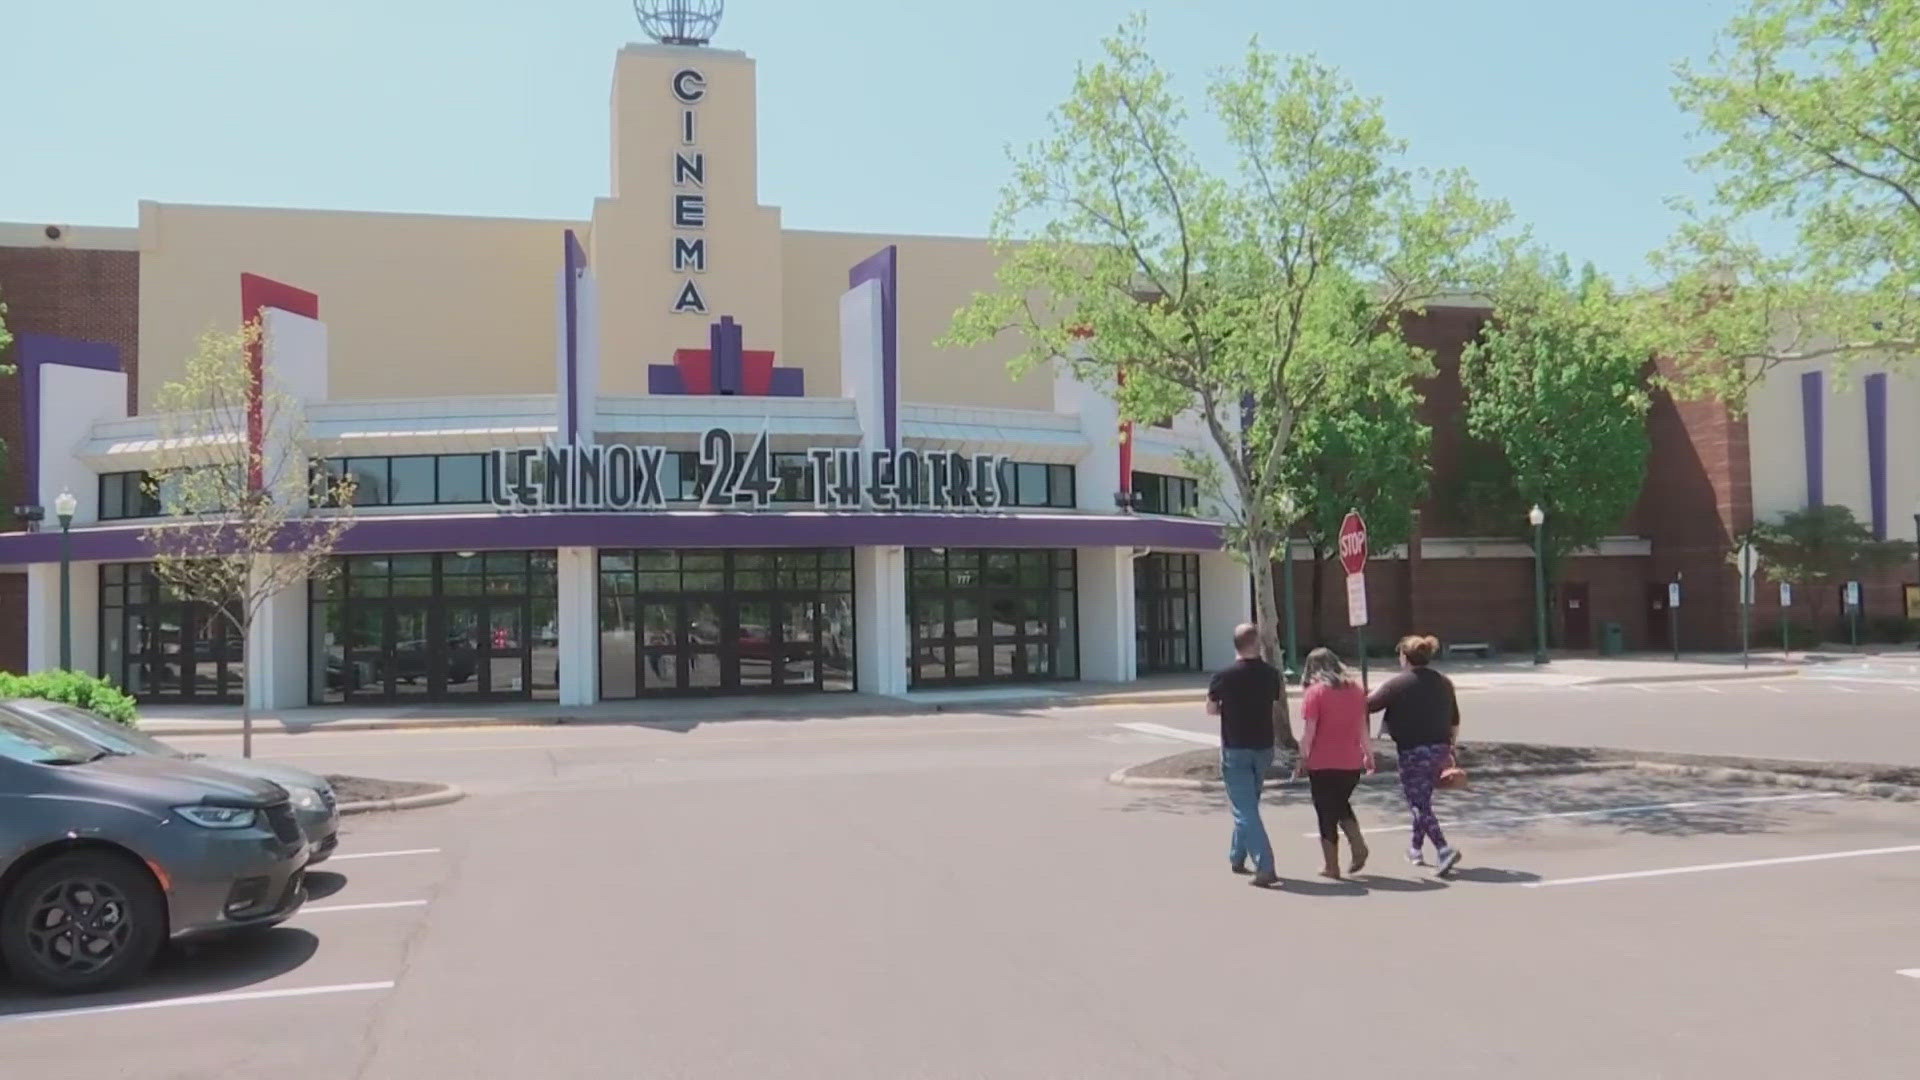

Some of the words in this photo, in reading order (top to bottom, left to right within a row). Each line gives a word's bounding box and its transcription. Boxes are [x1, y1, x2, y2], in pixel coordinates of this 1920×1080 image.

[670, 67, 709, 314] CINEMA
[491, 434, 667, 510] LENNOX
[699, 425, 780, 509] 24
[808, 447, 1012, 512] THEATRES
[1341, 531, 1365, 557] STOP
